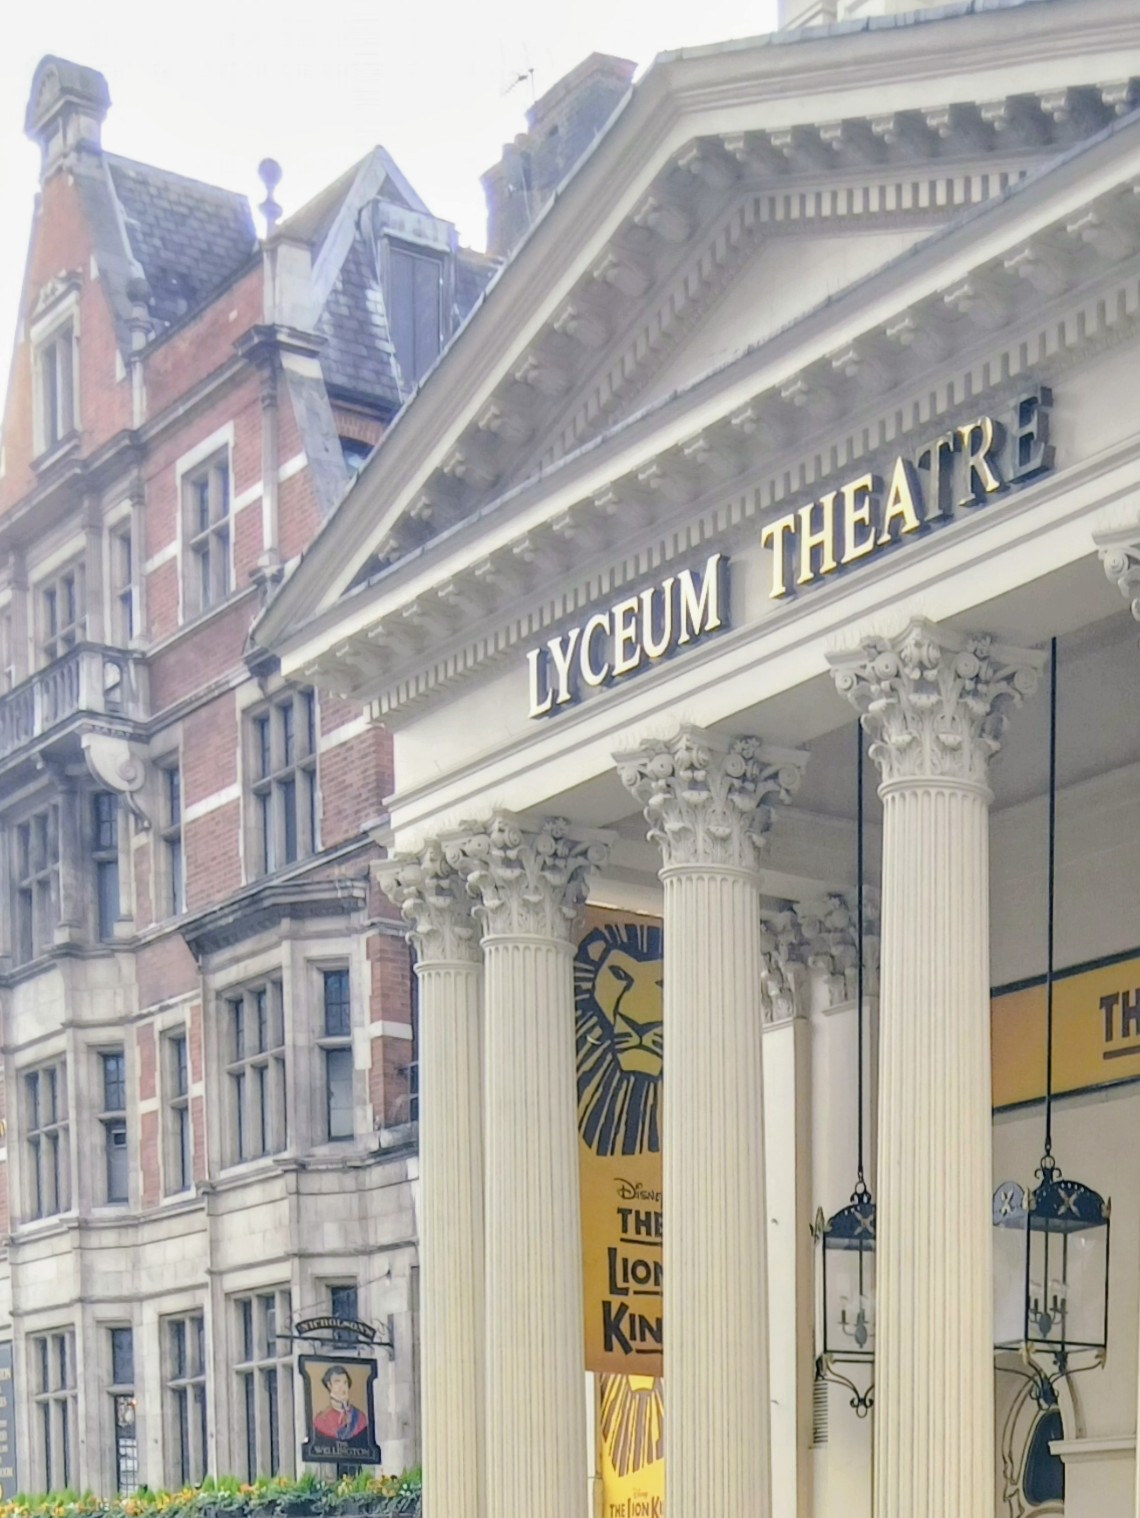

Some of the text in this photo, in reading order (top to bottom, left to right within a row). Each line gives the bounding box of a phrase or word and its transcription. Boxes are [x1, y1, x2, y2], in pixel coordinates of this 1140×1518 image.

[525, 386, 1056, 719] LYCEUM THEATRE
[609, 1503, 626, 1518] THE
